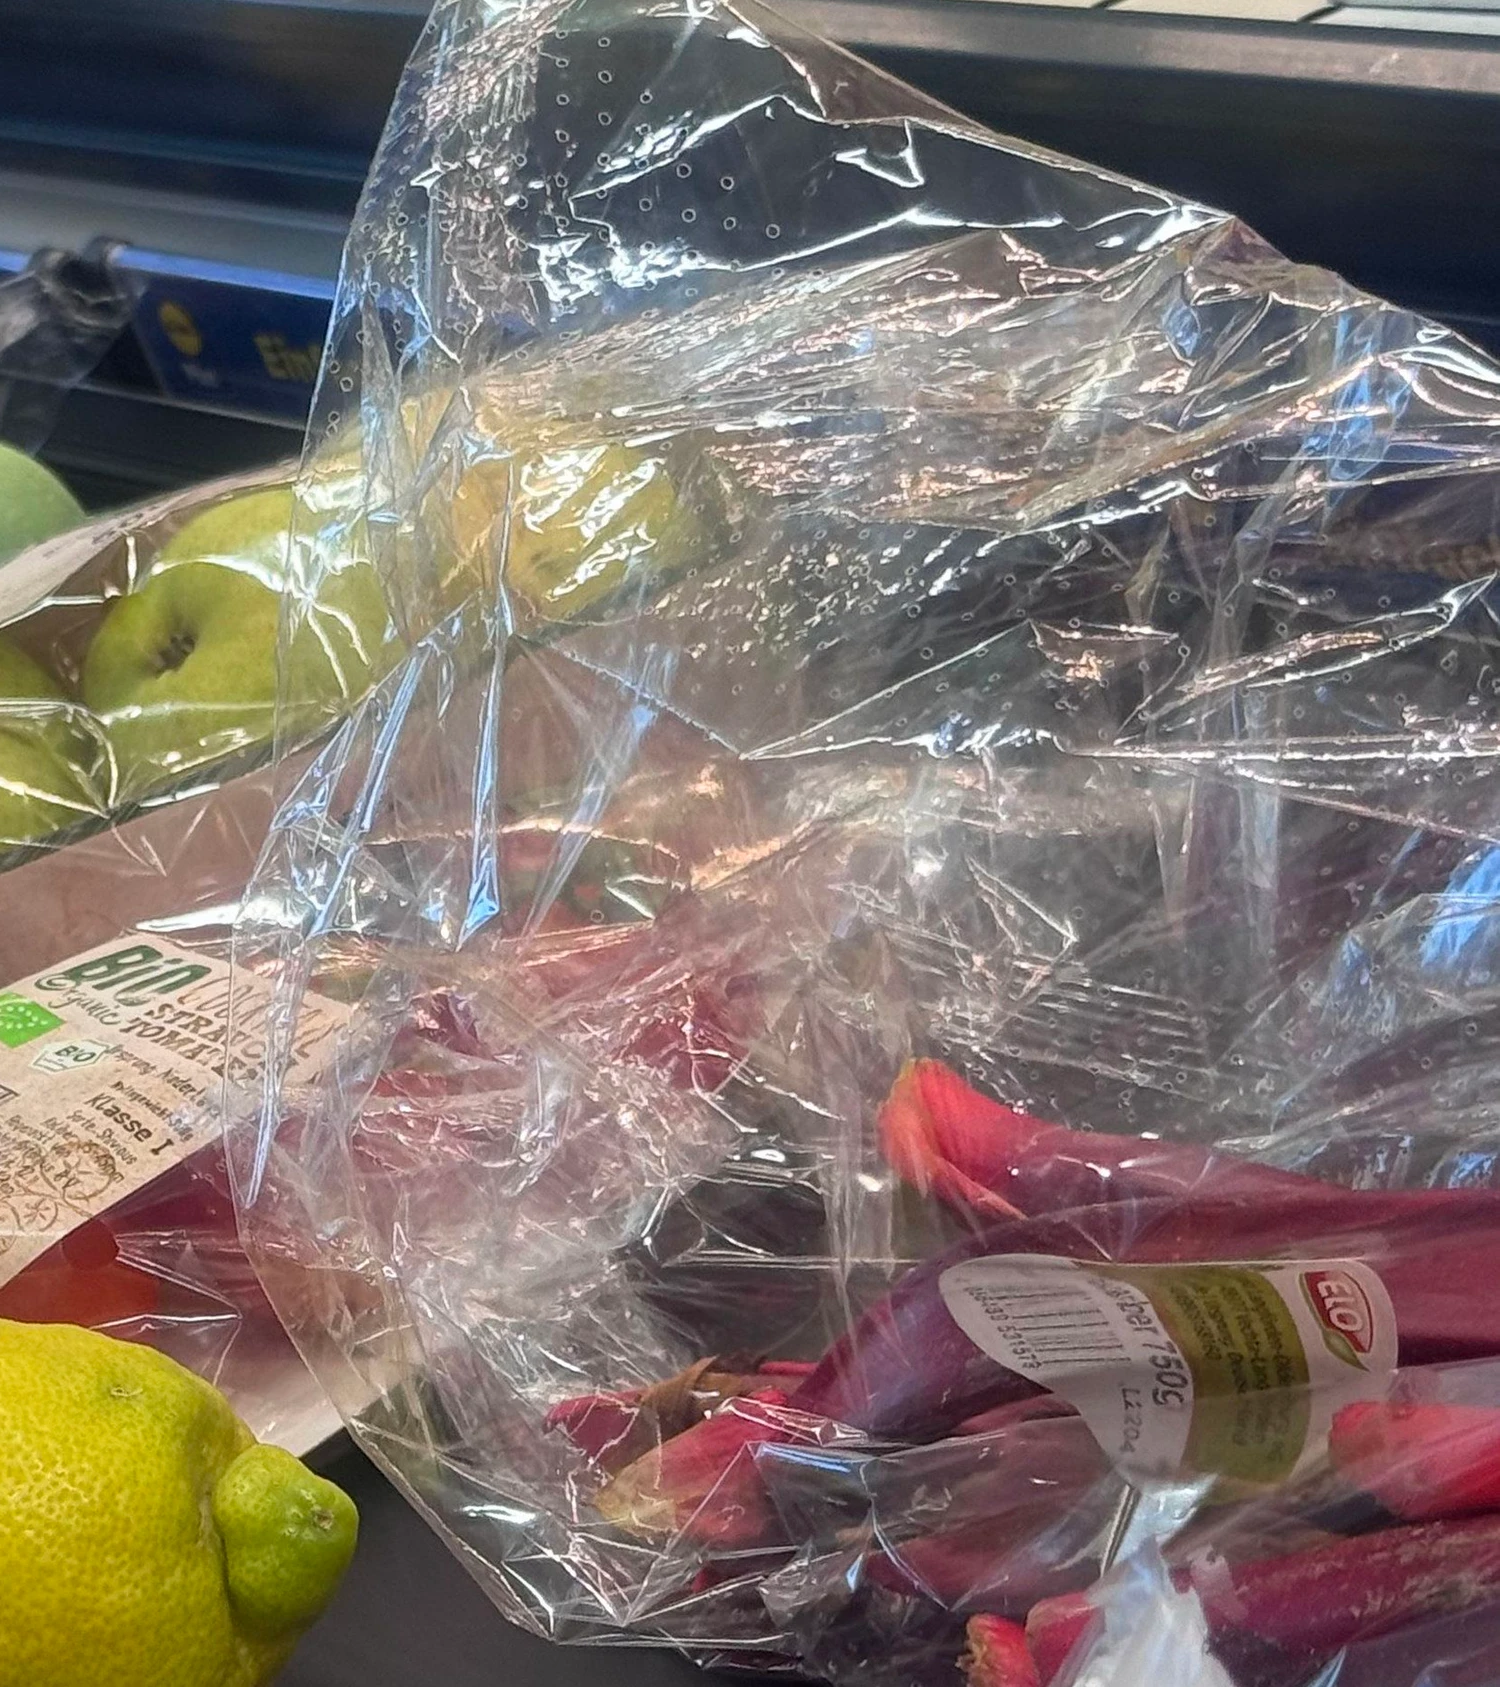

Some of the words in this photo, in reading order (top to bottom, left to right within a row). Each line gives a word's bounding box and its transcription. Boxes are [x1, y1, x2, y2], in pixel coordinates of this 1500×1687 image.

[55, 1045, 97, 1064] BIO
[85, 1093, 153, 1143] Klasse
[1316, 1279, 1365, 1332] ELO
[1142, 1340, 1190, 1406] 750g
